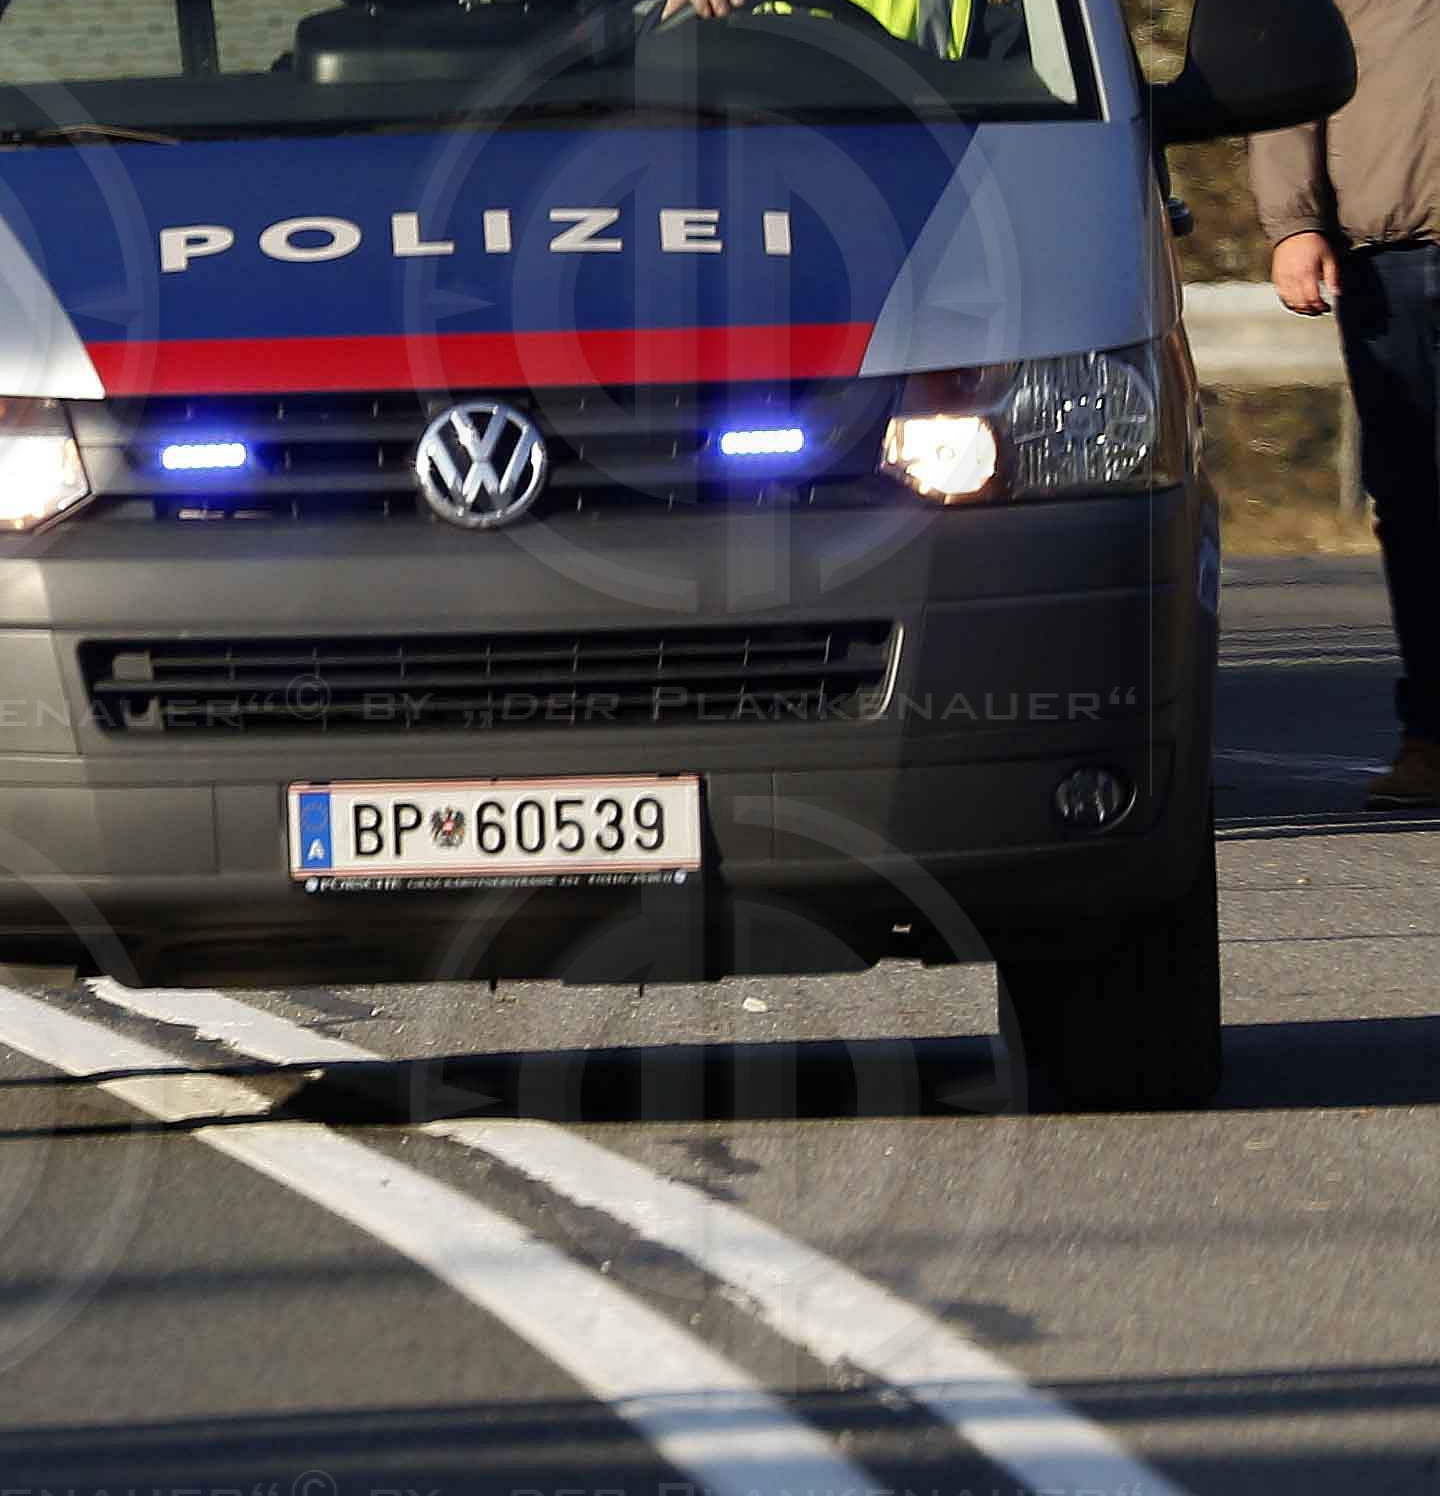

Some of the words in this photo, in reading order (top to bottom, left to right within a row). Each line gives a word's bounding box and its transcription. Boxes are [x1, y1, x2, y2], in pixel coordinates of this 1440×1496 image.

[158, 208, 792, 273] POLIZEI
[351, 803, 423, 858] BP
[474, 796, 666, 856] 60539
